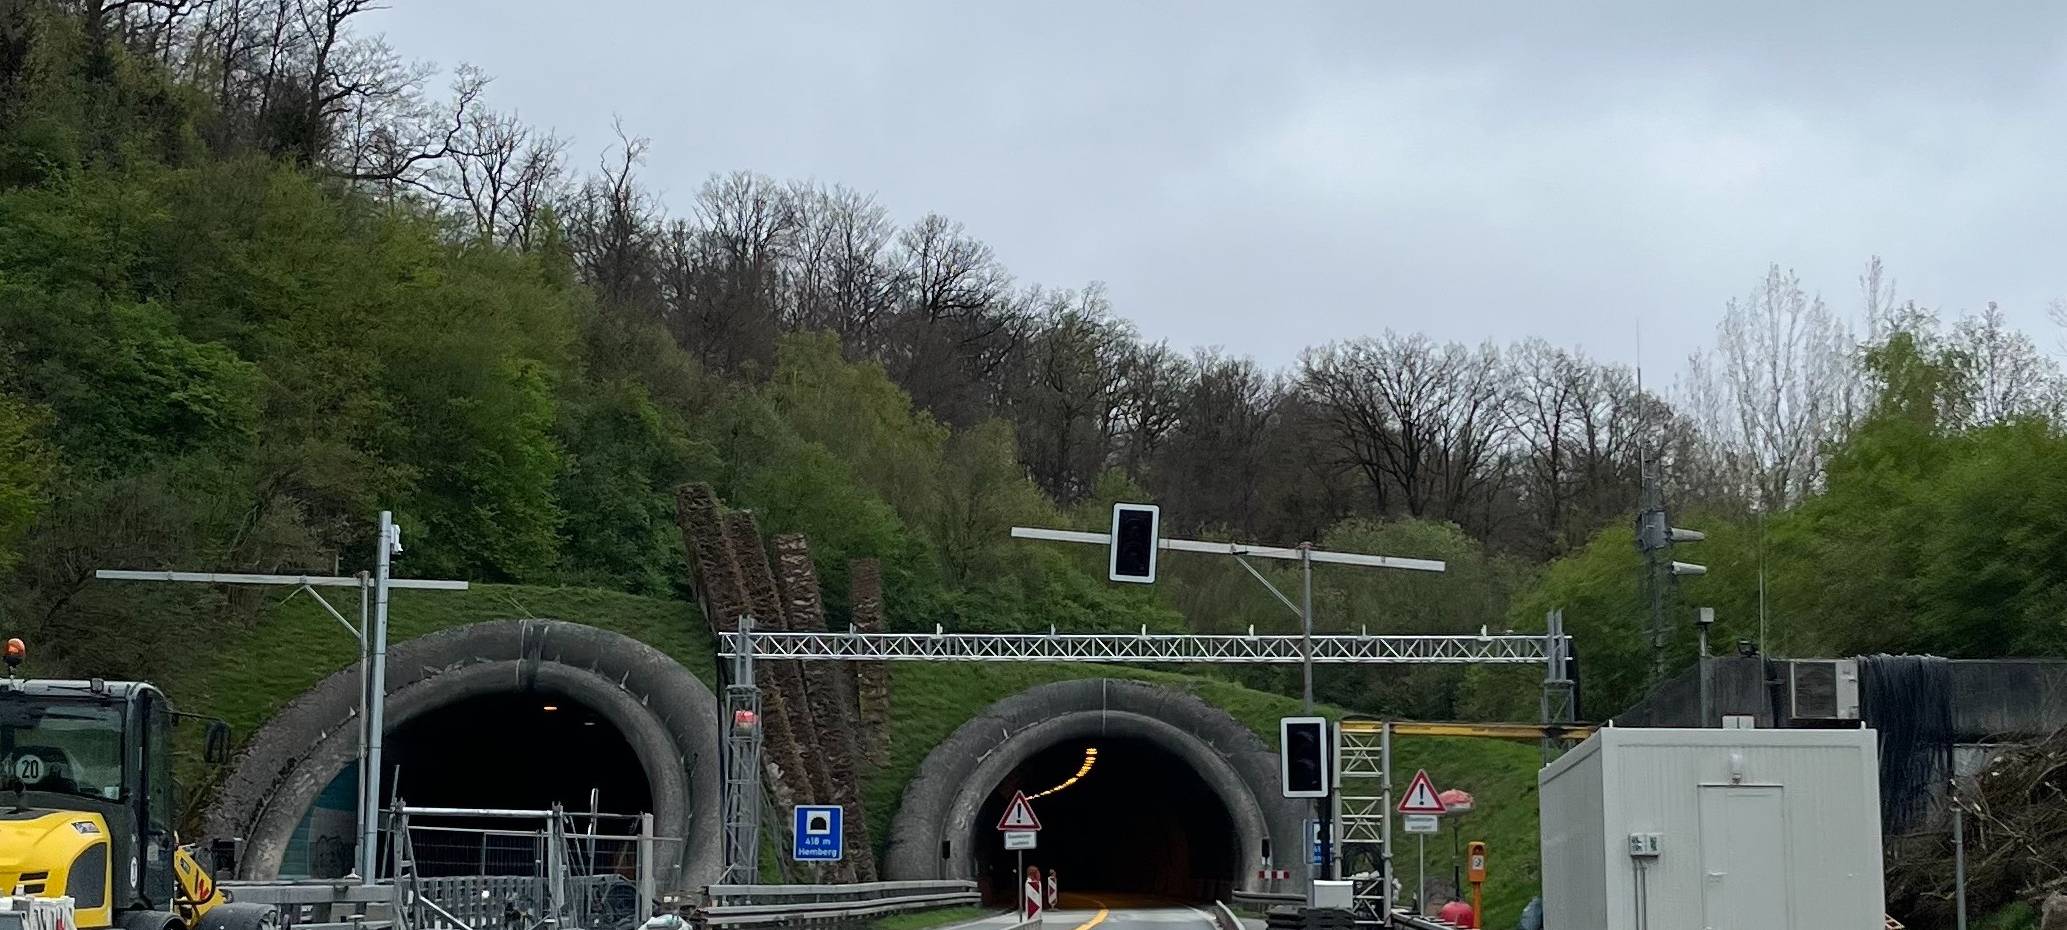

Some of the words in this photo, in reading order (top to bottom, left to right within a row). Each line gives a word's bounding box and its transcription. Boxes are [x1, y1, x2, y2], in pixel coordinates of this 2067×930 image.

[22, 760, 39, 779] 20
[822, 838, 831, 846] m
[798, 848, 837, 858] Hemberg
